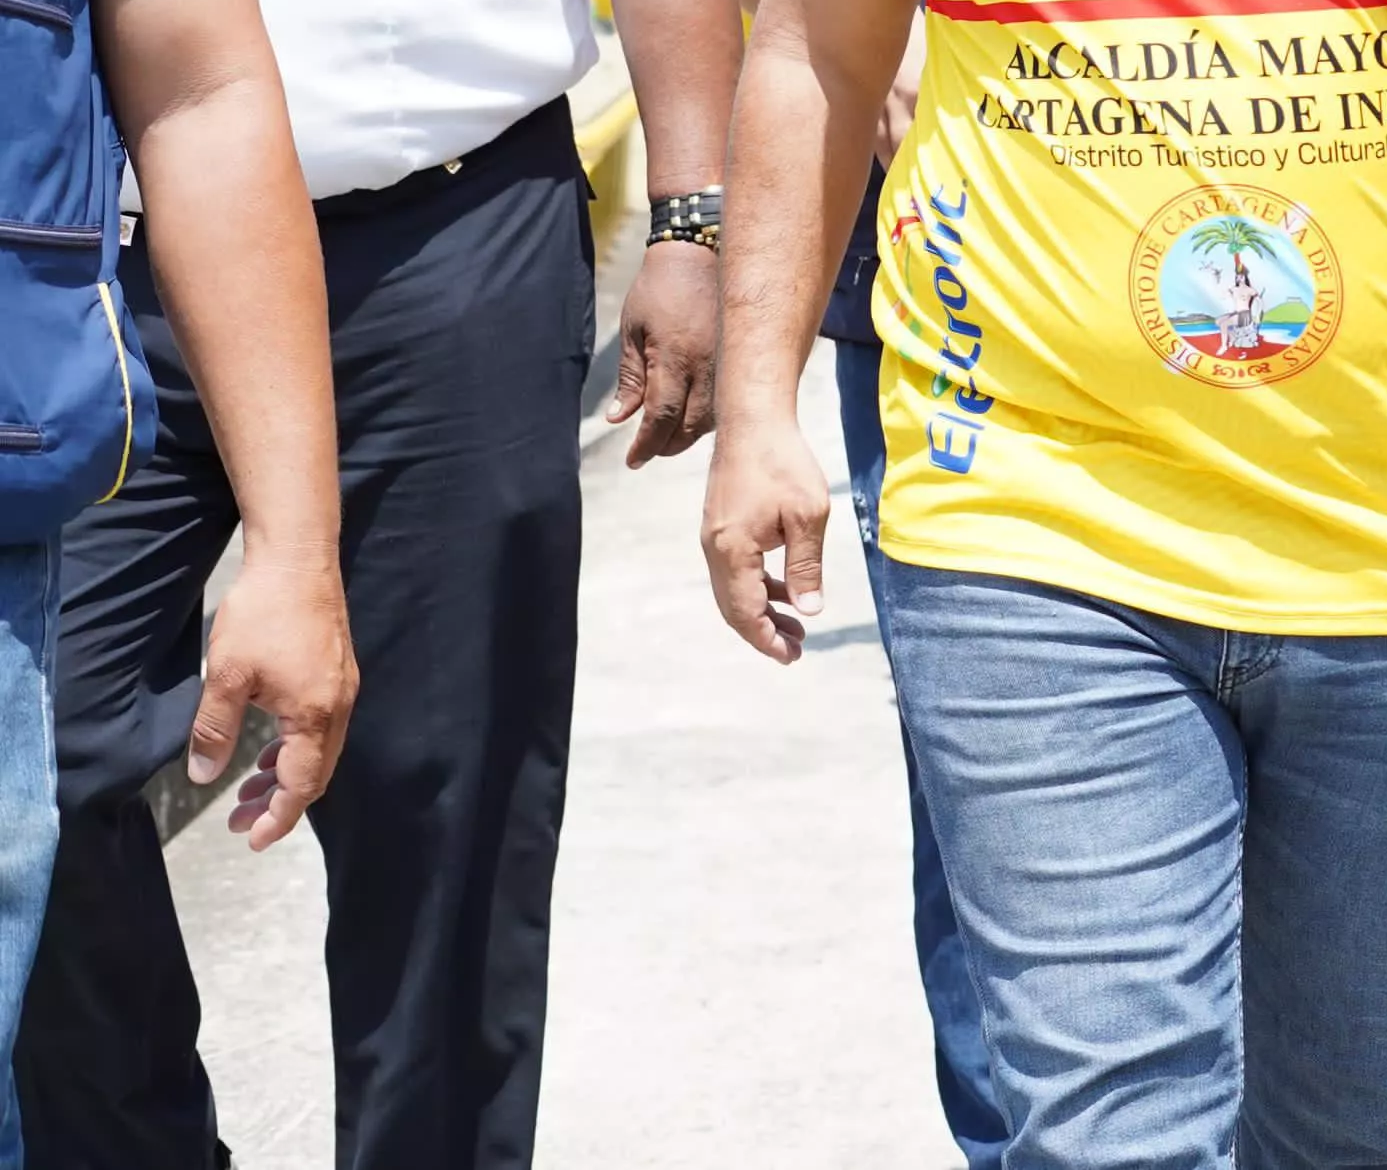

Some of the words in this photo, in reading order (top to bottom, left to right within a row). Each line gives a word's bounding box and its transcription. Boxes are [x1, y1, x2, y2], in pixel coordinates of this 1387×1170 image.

[1005, 29, 1239, 82] ALCALDÍA
[976, 93, 1232, 137] CARTAGENA
[1247, 95, 1321, 135] DE
[1050, 143, 1143, 168] Distrito
[1151, 143, 1266, 169] Turistico
[1274, 147, 1289, 171] y
[1161, 193, 1308, 245] CARTAGENA
[1138, 238, 1167, 272] DE
[1307, 246, 1333, 283] DE
[1138, 276, 1203, 371] DISTRITO
[1282, 289, 1335, 368] INDIAS
